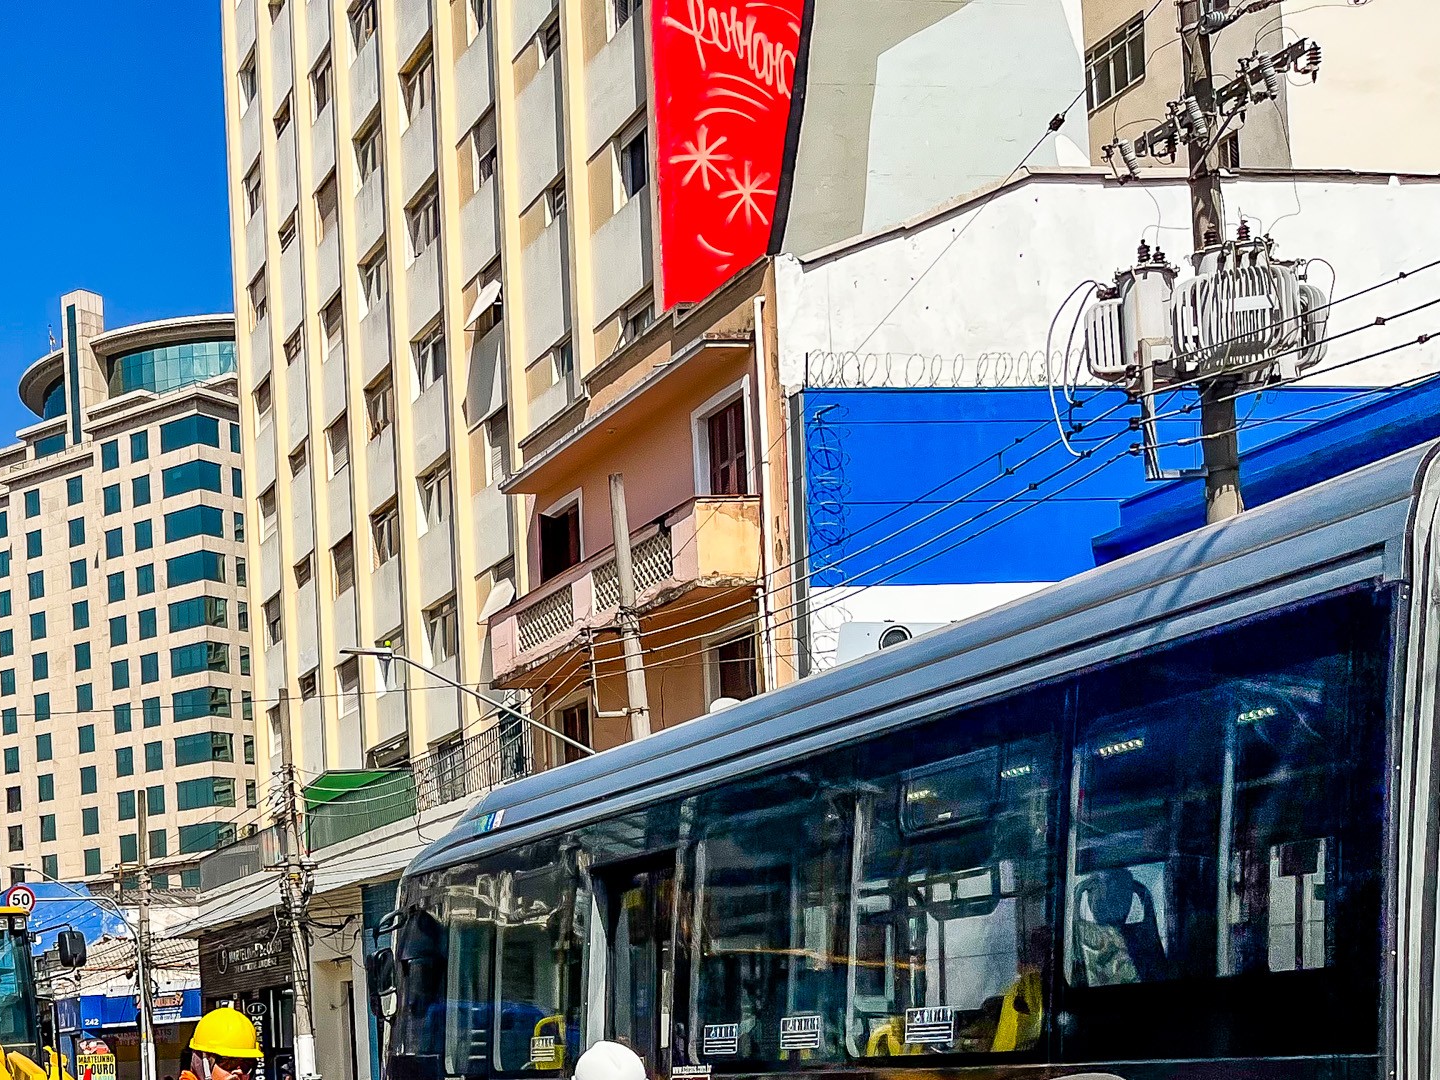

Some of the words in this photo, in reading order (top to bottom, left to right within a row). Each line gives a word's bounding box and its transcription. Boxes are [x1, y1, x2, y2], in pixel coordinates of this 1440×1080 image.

[12, 893, 30, 906] 50
[84, 1018, 99, 1026] 242
[78, 1055, 114, 1064] MARTELINHO
[91, 1063, 114, 1075] OURO
